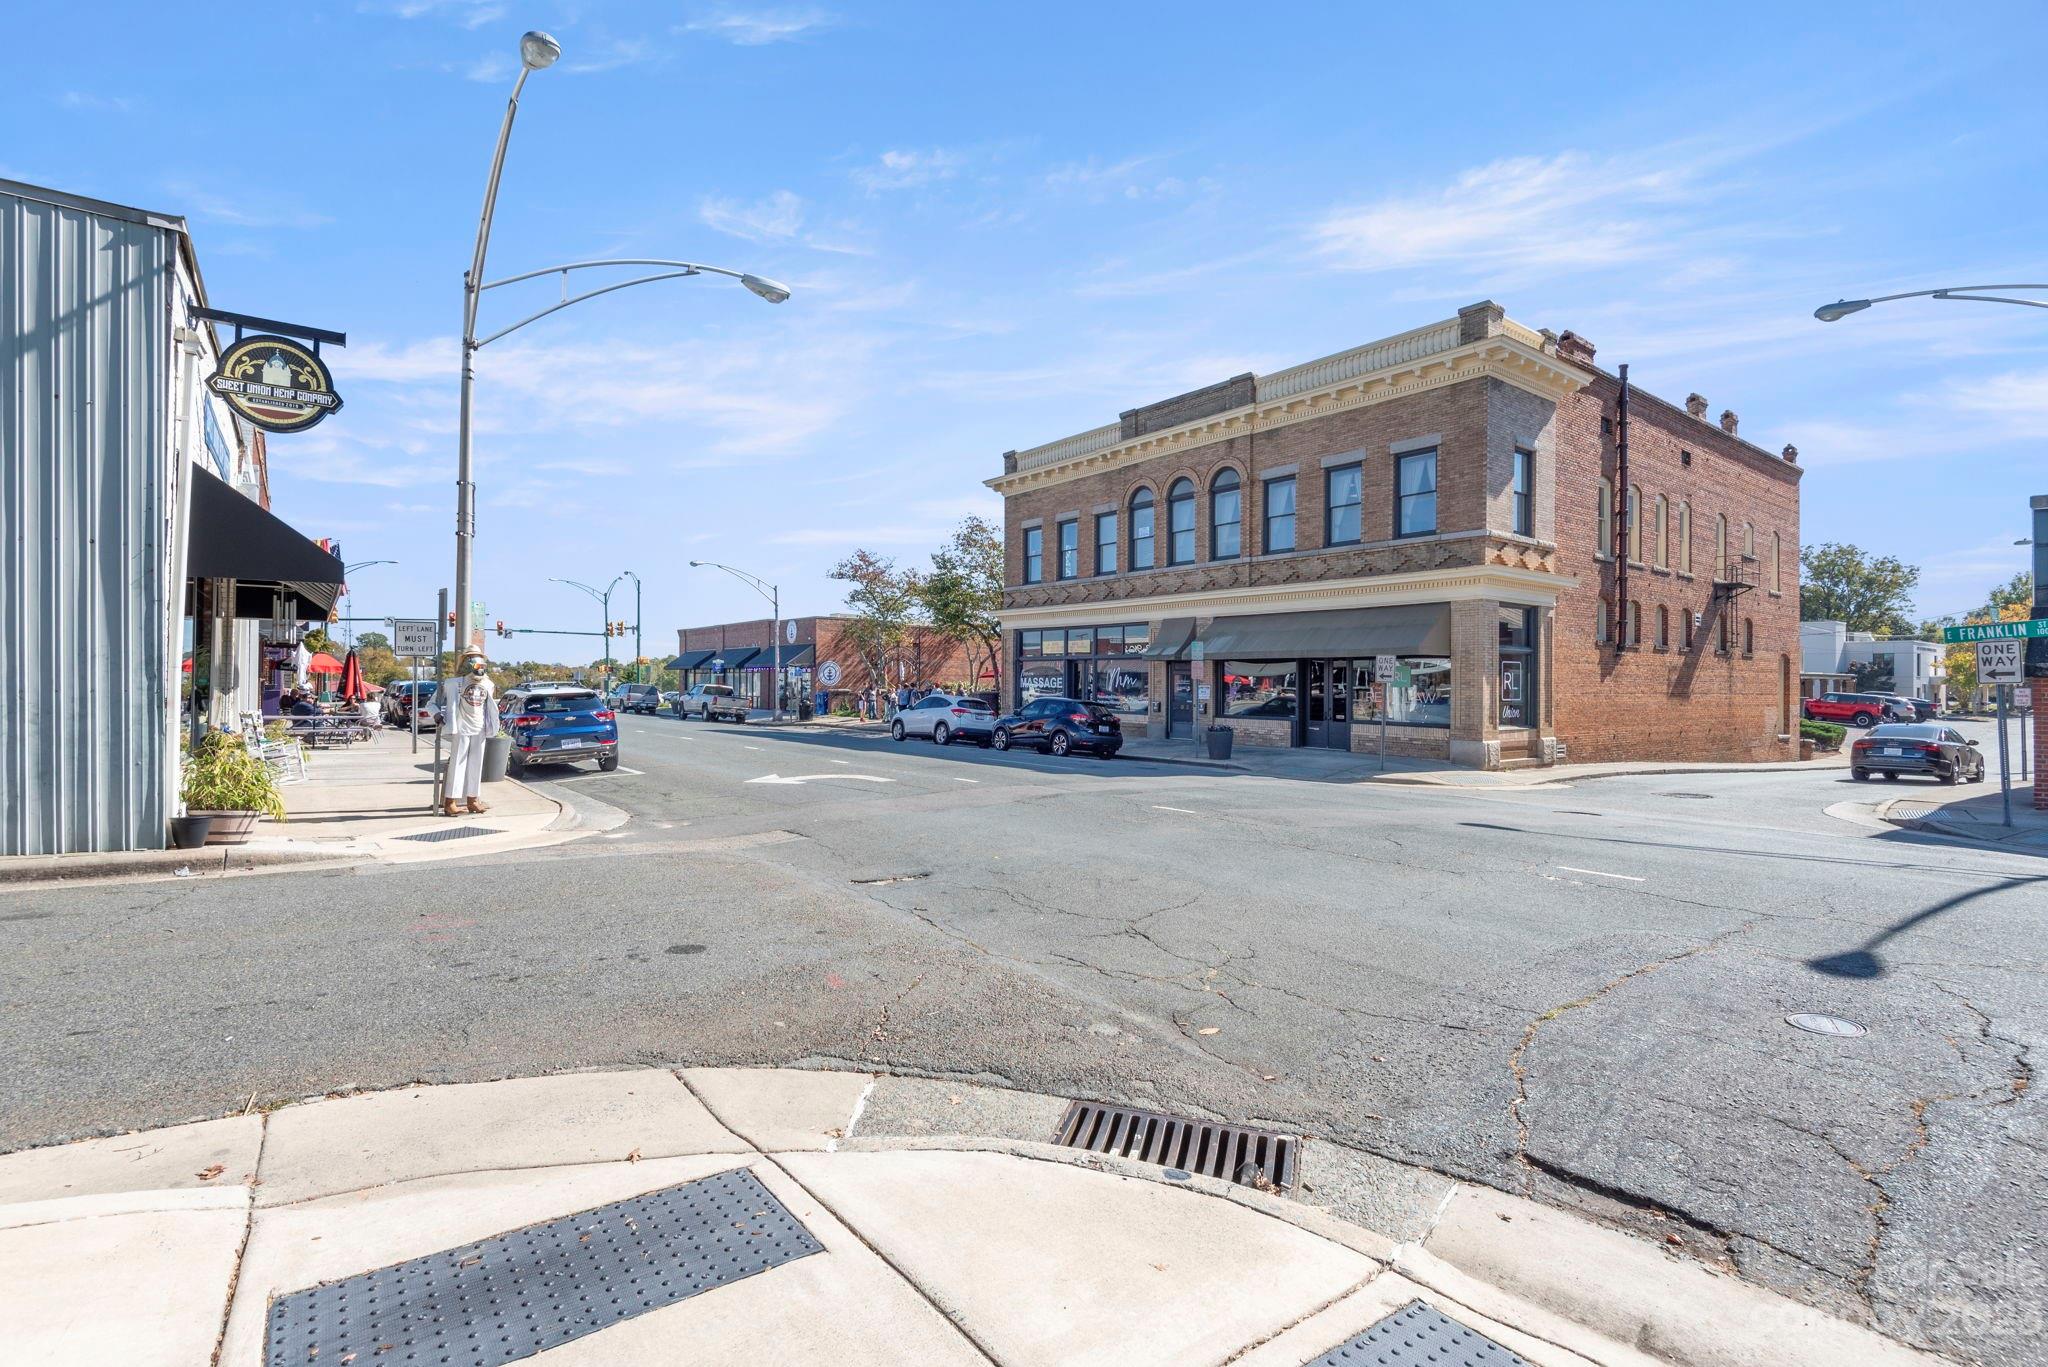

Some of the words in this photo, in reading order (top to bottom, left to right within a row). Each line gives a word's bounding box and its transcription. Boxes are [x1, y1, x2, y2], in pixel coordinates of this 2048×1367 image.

[217, 379, 245, 392] SWEET
[247, 383, 271, 396] UNION
[273, 387, 296, 399] HEMP
[297, 391, 333, 406] COMPANY
[1947, 631, 1952, 639] E
[1960, 623, 2027, 640] FRANKLIN
[404, 635, 427, 643] MUST
[1981, 644, 2015, 655] ONE
[1378, 657, 1393, 665] ONE
[1981, 656, 2017, 667] WAY
[1020, 677, 1063, 688] MASSAGE
[1504, 672, 1519, 690] RL
[1503, 705, 1520, 719] Union
